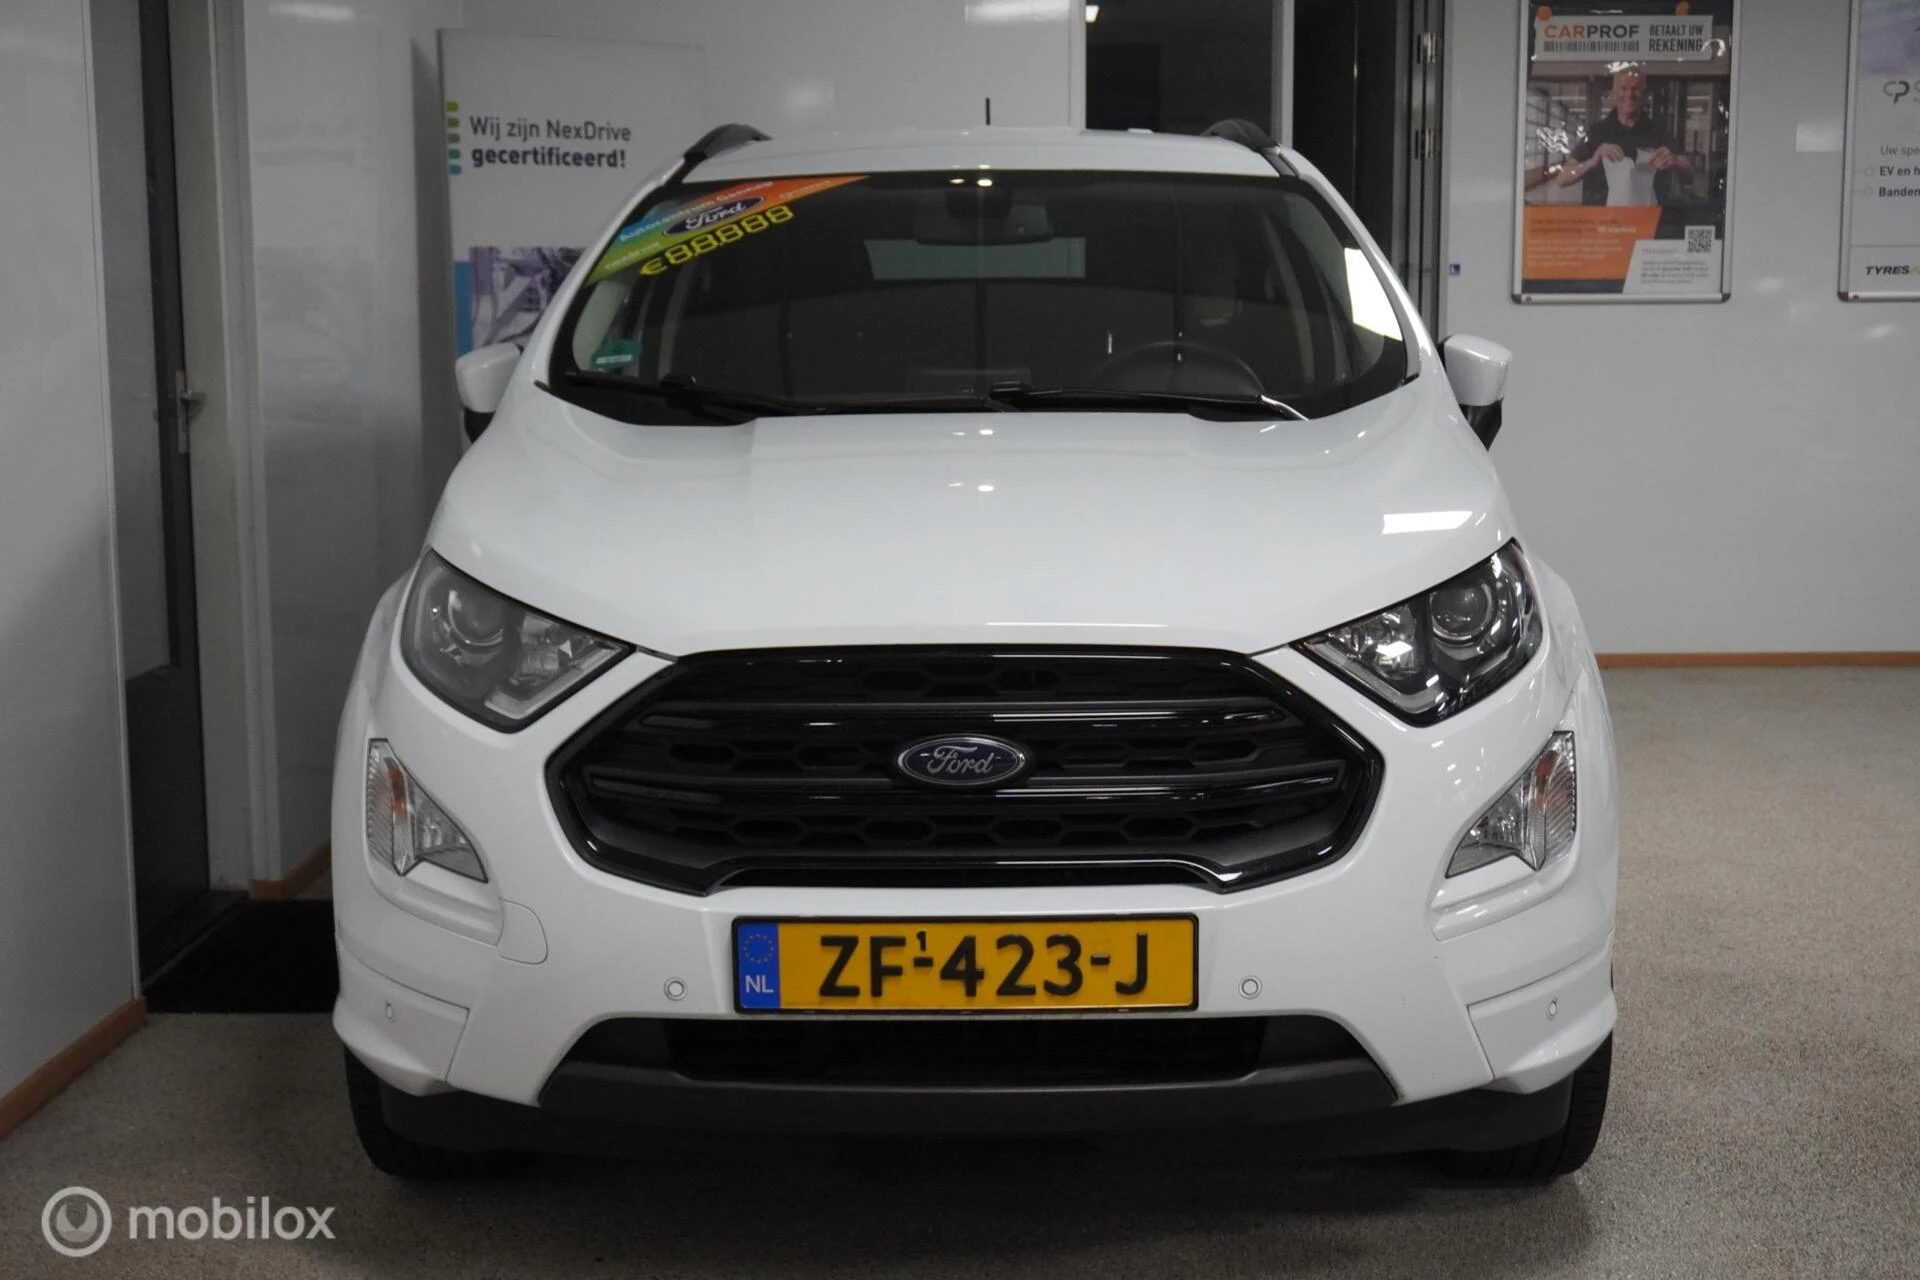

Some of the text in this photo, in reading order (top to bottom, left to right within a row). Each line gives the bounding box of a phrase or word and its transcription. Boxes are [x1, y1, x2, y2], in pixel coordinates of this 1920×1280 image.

[1544, 24, 1640, 39] CARPROF
[1649, 24, 1704, 37] BETAALT UW
[1648, 38, 1703, 53] REKENING
[470, 116, 632, 143] Wij zijn NexDrive
[471, 147, 627, 169] gecertificeerd!
[1880, 144, 1898, 156] Uw
[1879, 165, 1895, 177] EV
[1896, 167, 1911, 177] en
[684, 202, 748, 231] Ford
[926, 745, 996, 776] Ford
[744, 974, 775, 994] NL
